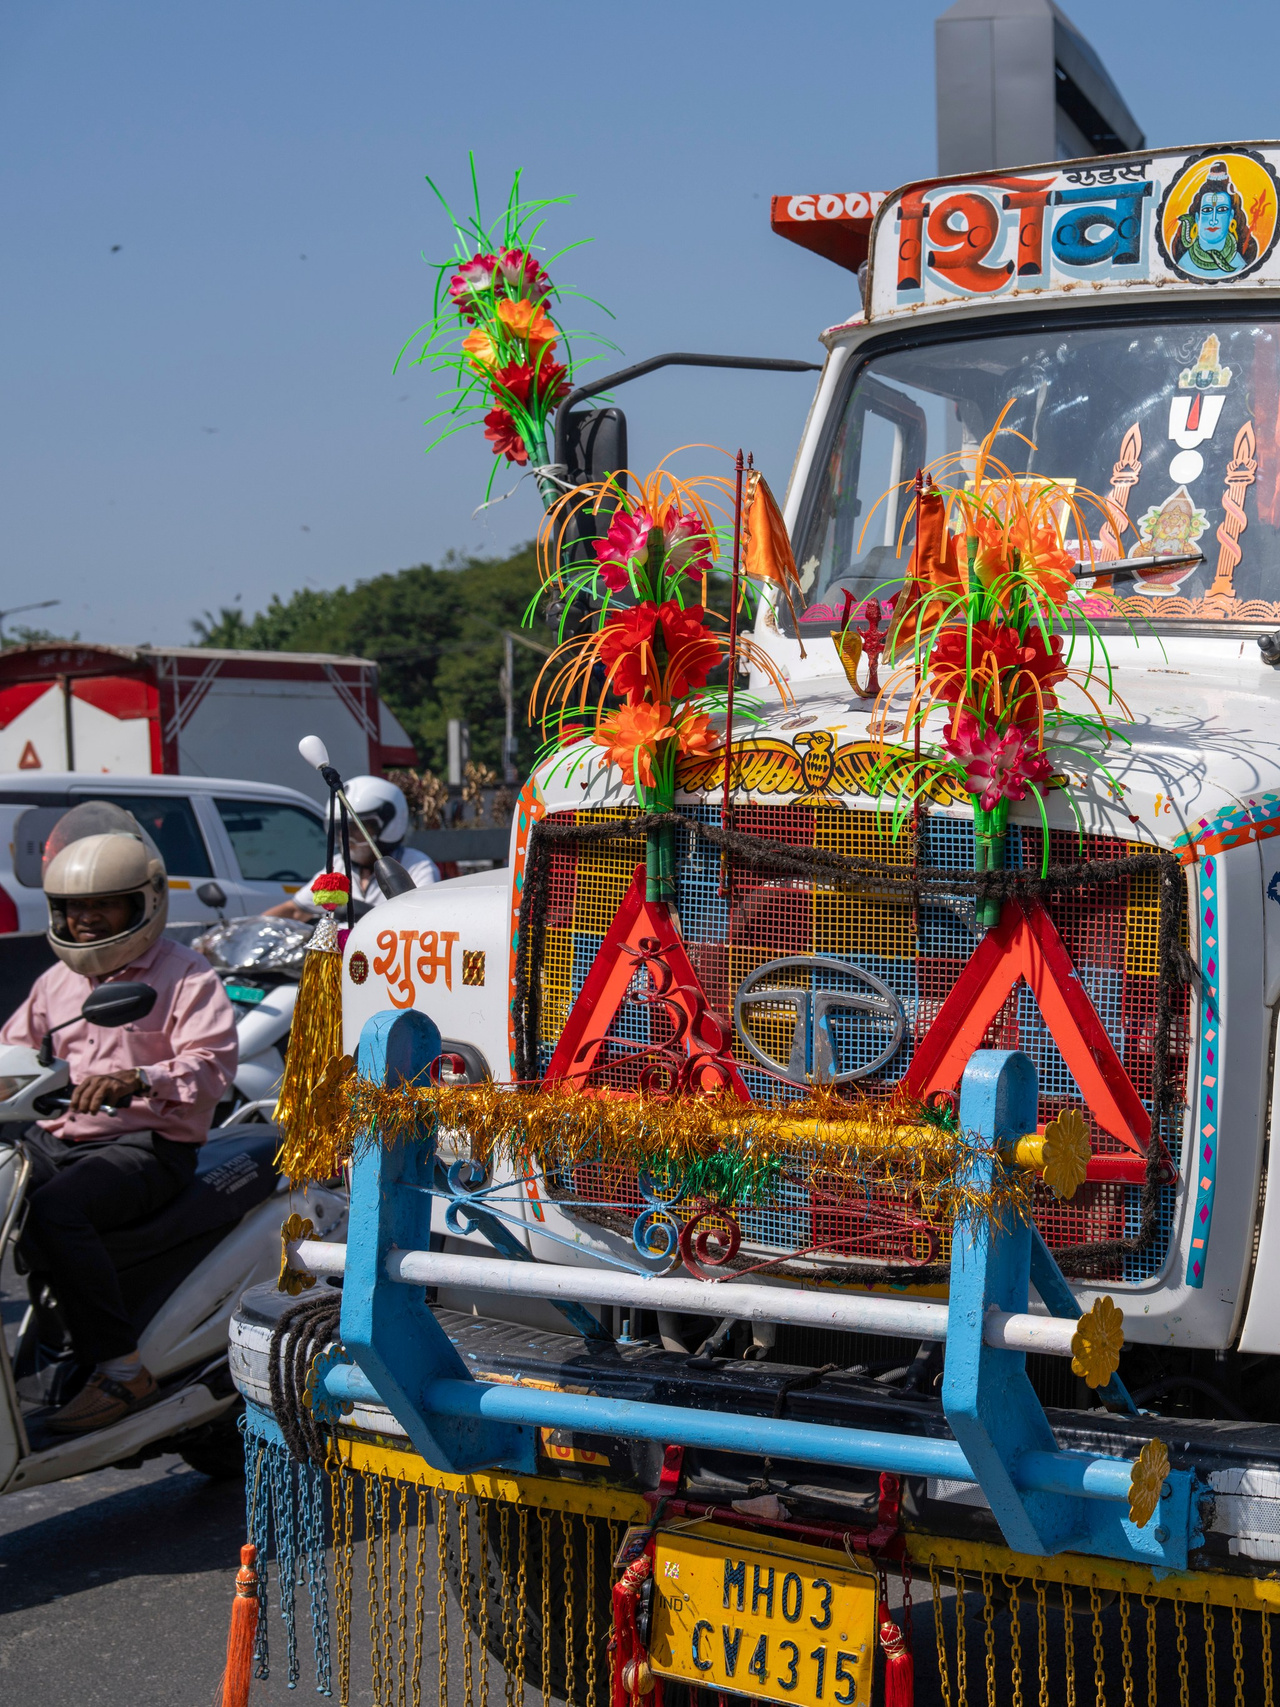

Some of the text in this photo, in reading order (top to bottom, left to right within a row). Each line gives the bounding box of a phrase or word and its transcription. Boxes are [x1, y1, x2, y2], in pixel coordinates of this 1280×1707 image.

[897, 175, 1153, 293] शिव
[373, 930, 460, 1009] शुभ
[660, 1596, 683, 1612] IND
[722, 1557, 834, 1630] MH03
[692, 1619, 858, 1705] CV4315
